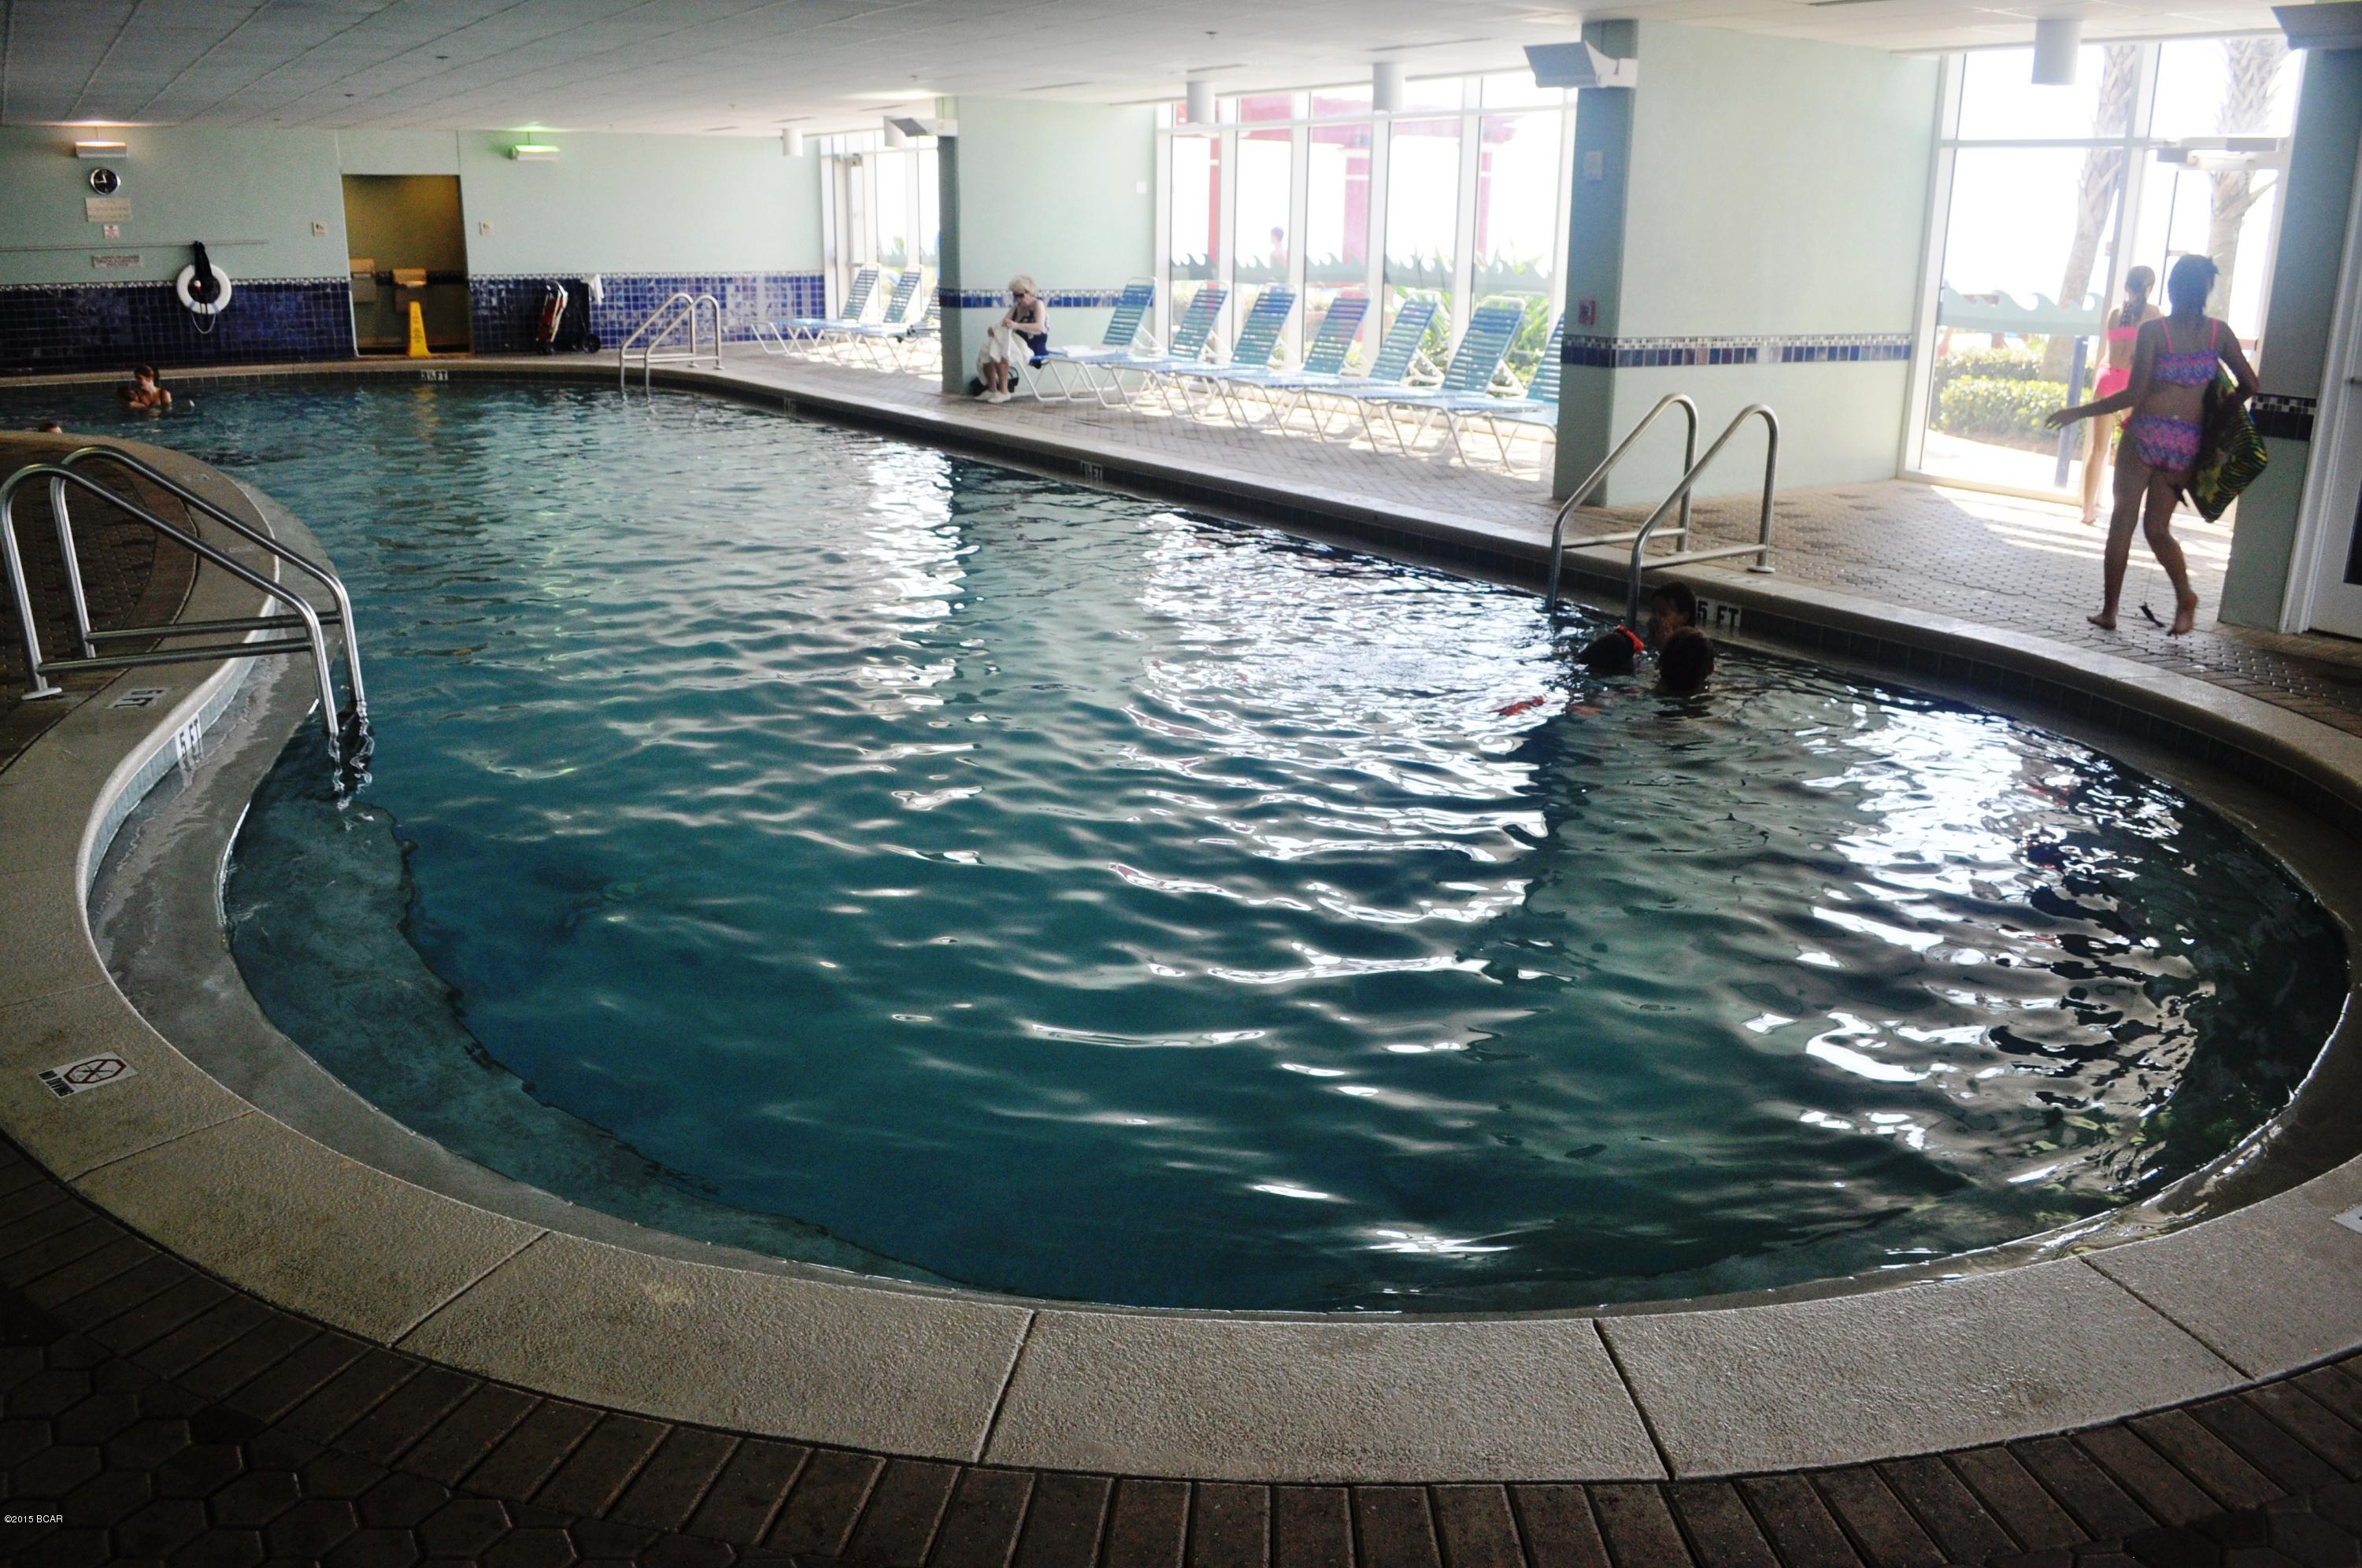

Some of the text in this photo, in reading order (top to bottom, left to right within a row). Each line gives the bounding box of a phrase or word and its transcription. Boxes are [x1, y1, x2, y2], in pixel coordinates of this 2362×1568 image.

[1697, 600, 1739, 629] 5 FT
[179, 718, 201, 756] 5 FT
